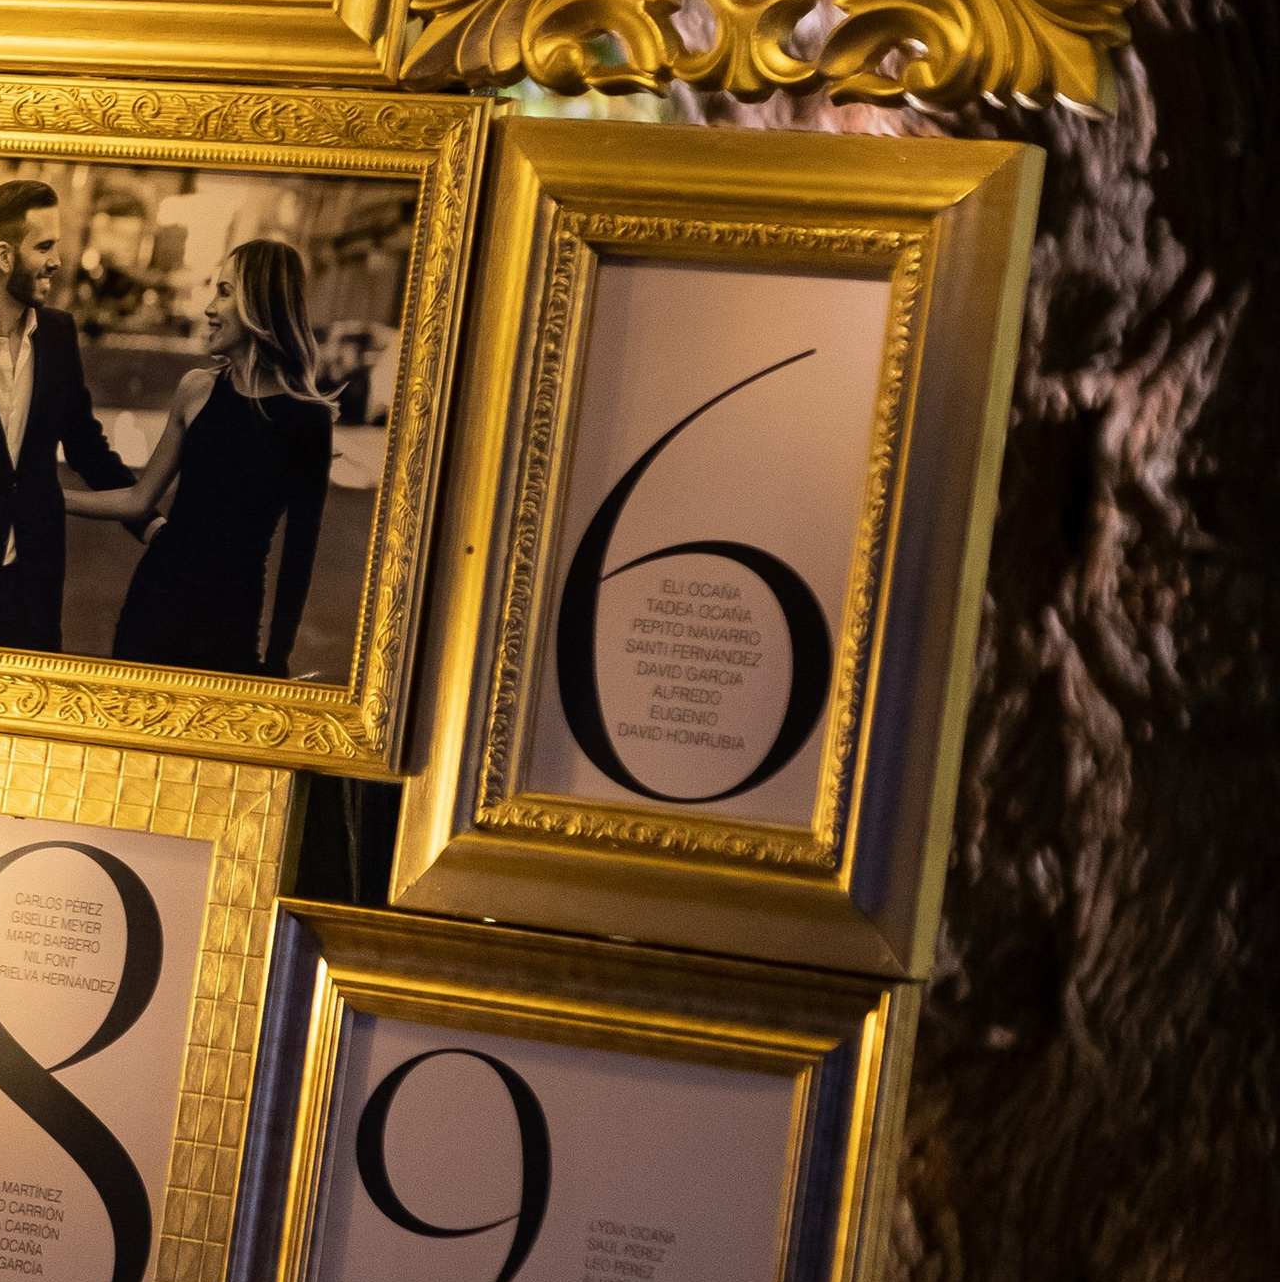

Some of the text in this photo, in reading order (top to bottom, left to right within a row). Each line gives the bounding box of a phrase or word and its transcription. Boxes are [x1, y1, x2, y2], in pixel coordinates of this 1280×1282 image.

[557, 348, 833, 804] 6
[662, 579, 683, 594] ELI
[633, 619, 761, 646] PEPITO NAVARRO
[625, 639, 668, 657] SANTI
[637, 661, 682, 679] DAVID
[652, 685, 722, 705] ALFREDO
[650, 705, 718, 726] EUGENIO
[618, 722, 745, 750] DAVID HONRUBIA
[15, 892, 62, 911] CARLOS
[11, 910, 102, 935] GISELLE MEYER
[6, 929, 100, 954] MARC BARBERO
[23, 950, 77, 968] NIL FONT
